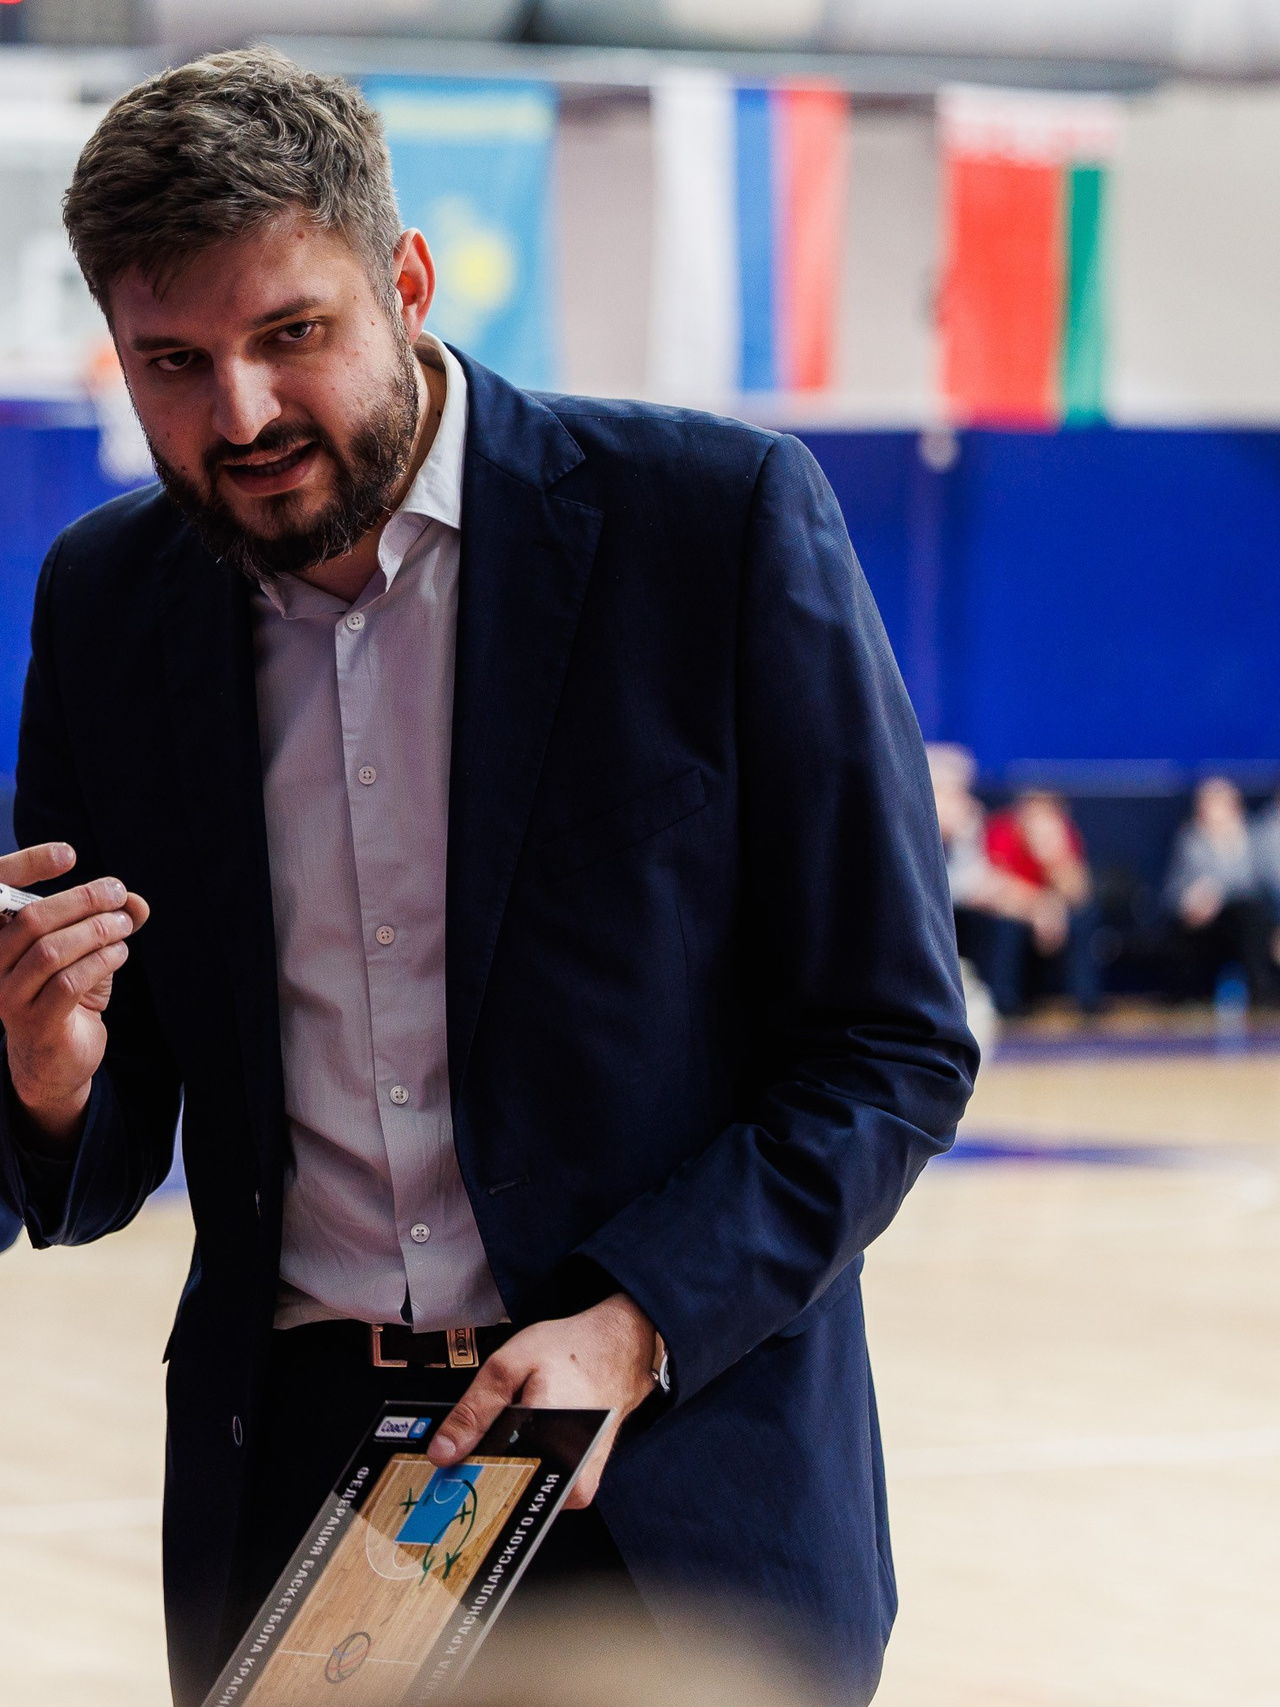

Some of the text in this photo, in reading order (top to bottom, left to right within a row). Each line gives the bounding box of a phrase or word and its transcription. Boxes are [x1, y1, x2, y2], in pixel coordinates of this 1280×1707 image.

[216, 1466, 370, 1707] ФЕДЕРАЦИЯ БАСКЕТБОЛА КРАСН
[444, 1517, 534, 1655] КРАСНОДАРСКОГО
[528, 1474, 560, 1512] КРАЯ
